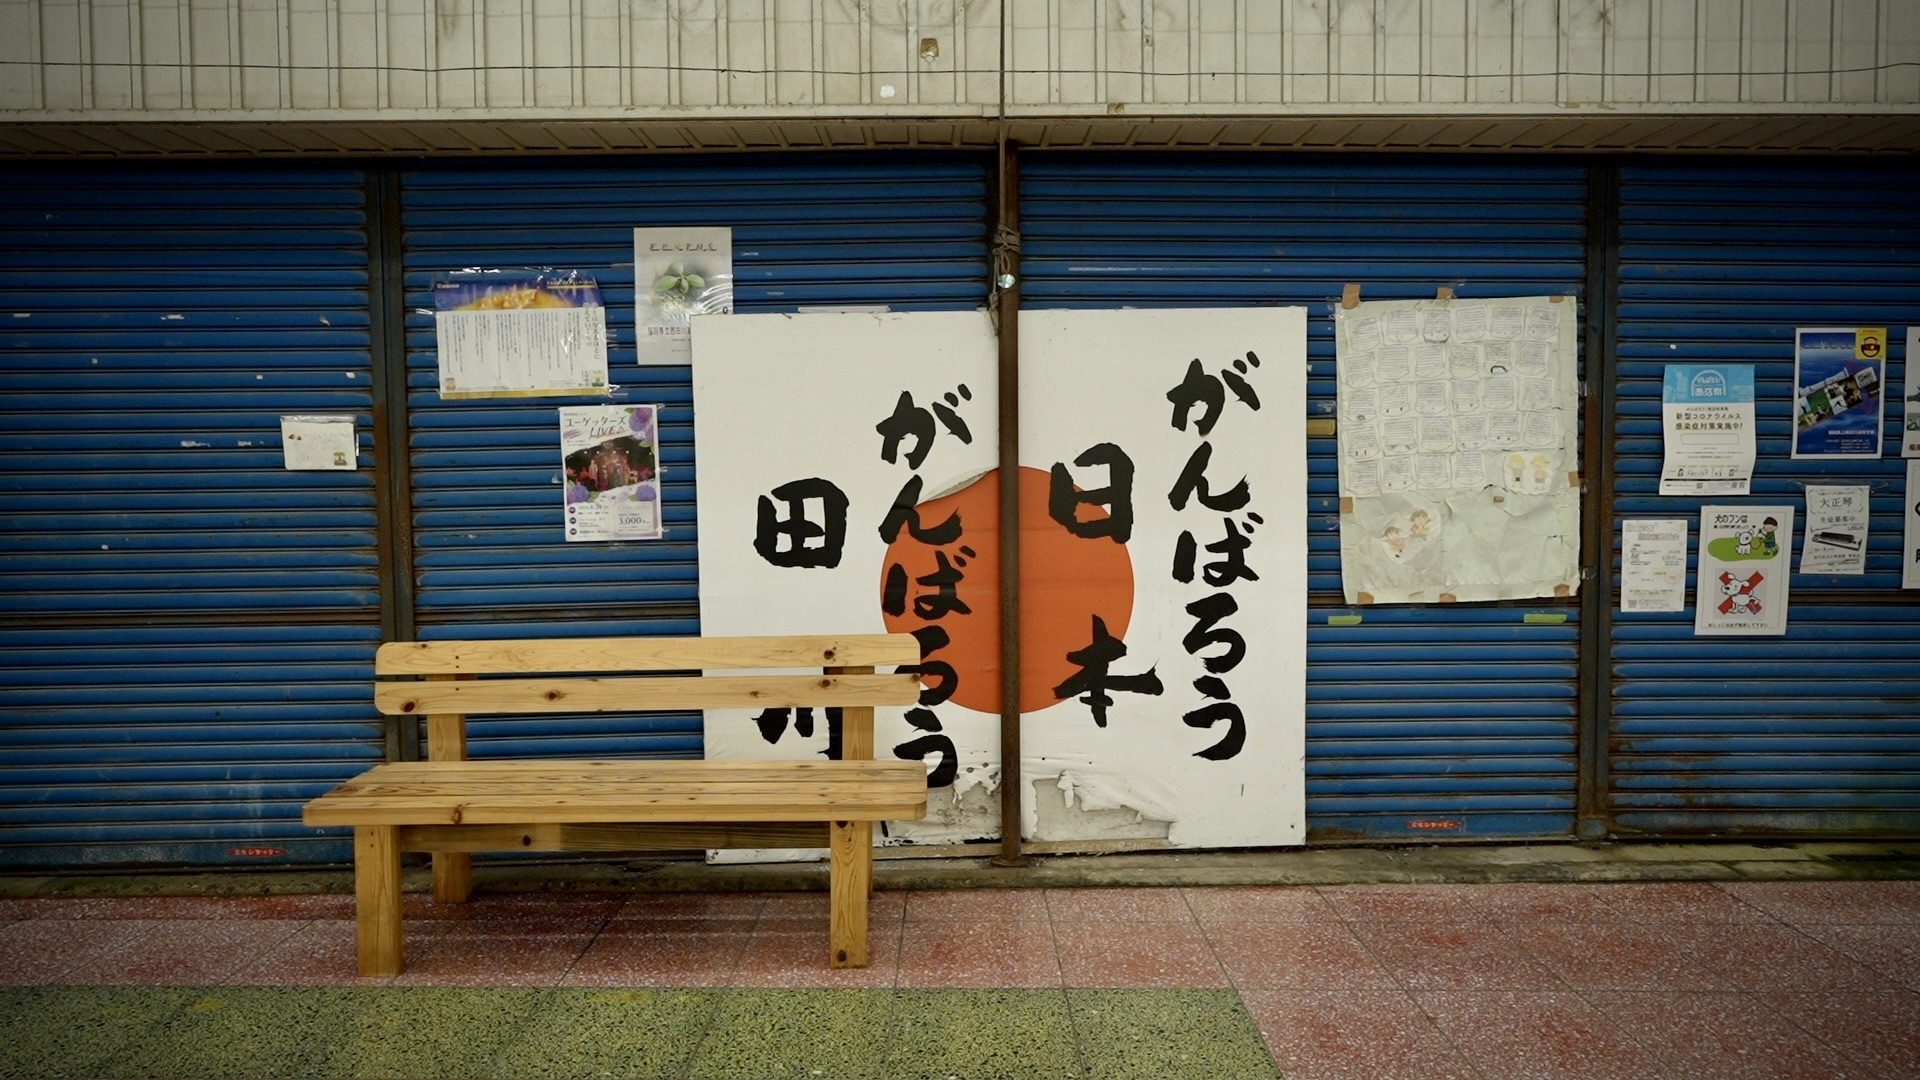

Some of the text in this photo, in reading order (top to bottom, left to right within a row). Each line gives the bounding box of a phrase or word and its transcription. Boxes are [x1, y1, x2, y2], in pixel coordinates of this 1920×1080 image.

[876, 383, 974, 788] がんばろう
[1048, 442, 1164, 728] 日本
[1167, 351, 1264, 761] がんばろう
[1715, 514, 1748, 523] 犬のフンは
[1819, 497, 1853, 508] 大正琴
